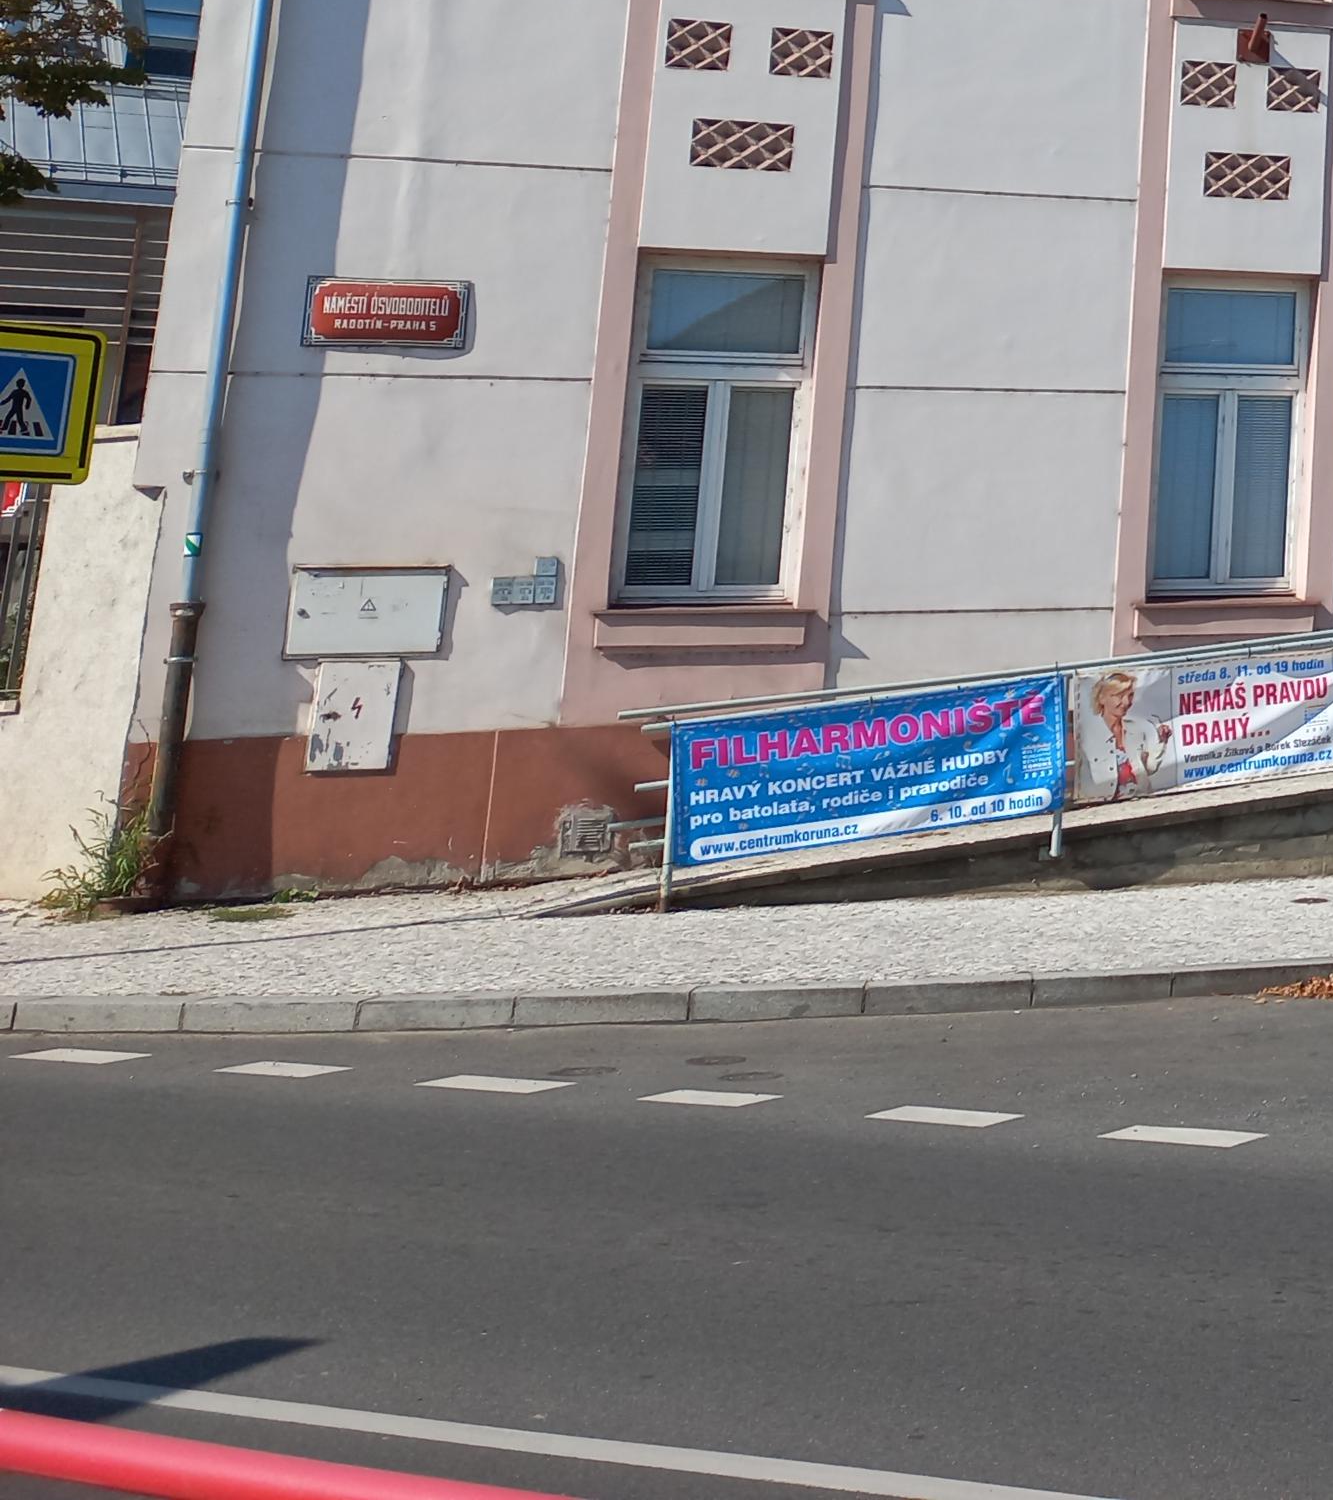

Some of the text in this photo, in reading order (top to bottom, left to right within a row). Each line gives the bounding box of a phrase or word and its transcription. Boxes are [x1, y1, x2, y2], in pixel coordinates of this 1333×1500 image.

[323, 292, 368, 314] NÁMĚSTÍ
[429, 320, 436, 331] 5
[1178, 658, 1325, 685] středa 8. 11. od 19 hodin
[1179, 677, 1328, 716] NEMÁŠ PRAVDU
[690, 690, 1046, 772] FILHARMONIŠTĚ
[1181, 712, 1270, 747] DRAHÝ...
[1184, 752, 1222, 763] Veronika
[1293, 734, 1332, 748] Slezáček
[1184, 748, 1333, 778] www.centrumkoruna.cz
[690, 781, 761, 806] HRAVÝ
[768, 770, 864, 795] KONCERT
[871, 758, 936, 781] VÁŽNÉ
[942, 749, 1008, 772] HUDBY
[690, 773, 989, 830] pro batolata, rodiče i prarodiče
[930, 795, 1043, 823] 6. 10. od 10 hodin
[701, 824, 859, 856] www.centrumkoruna.cz
